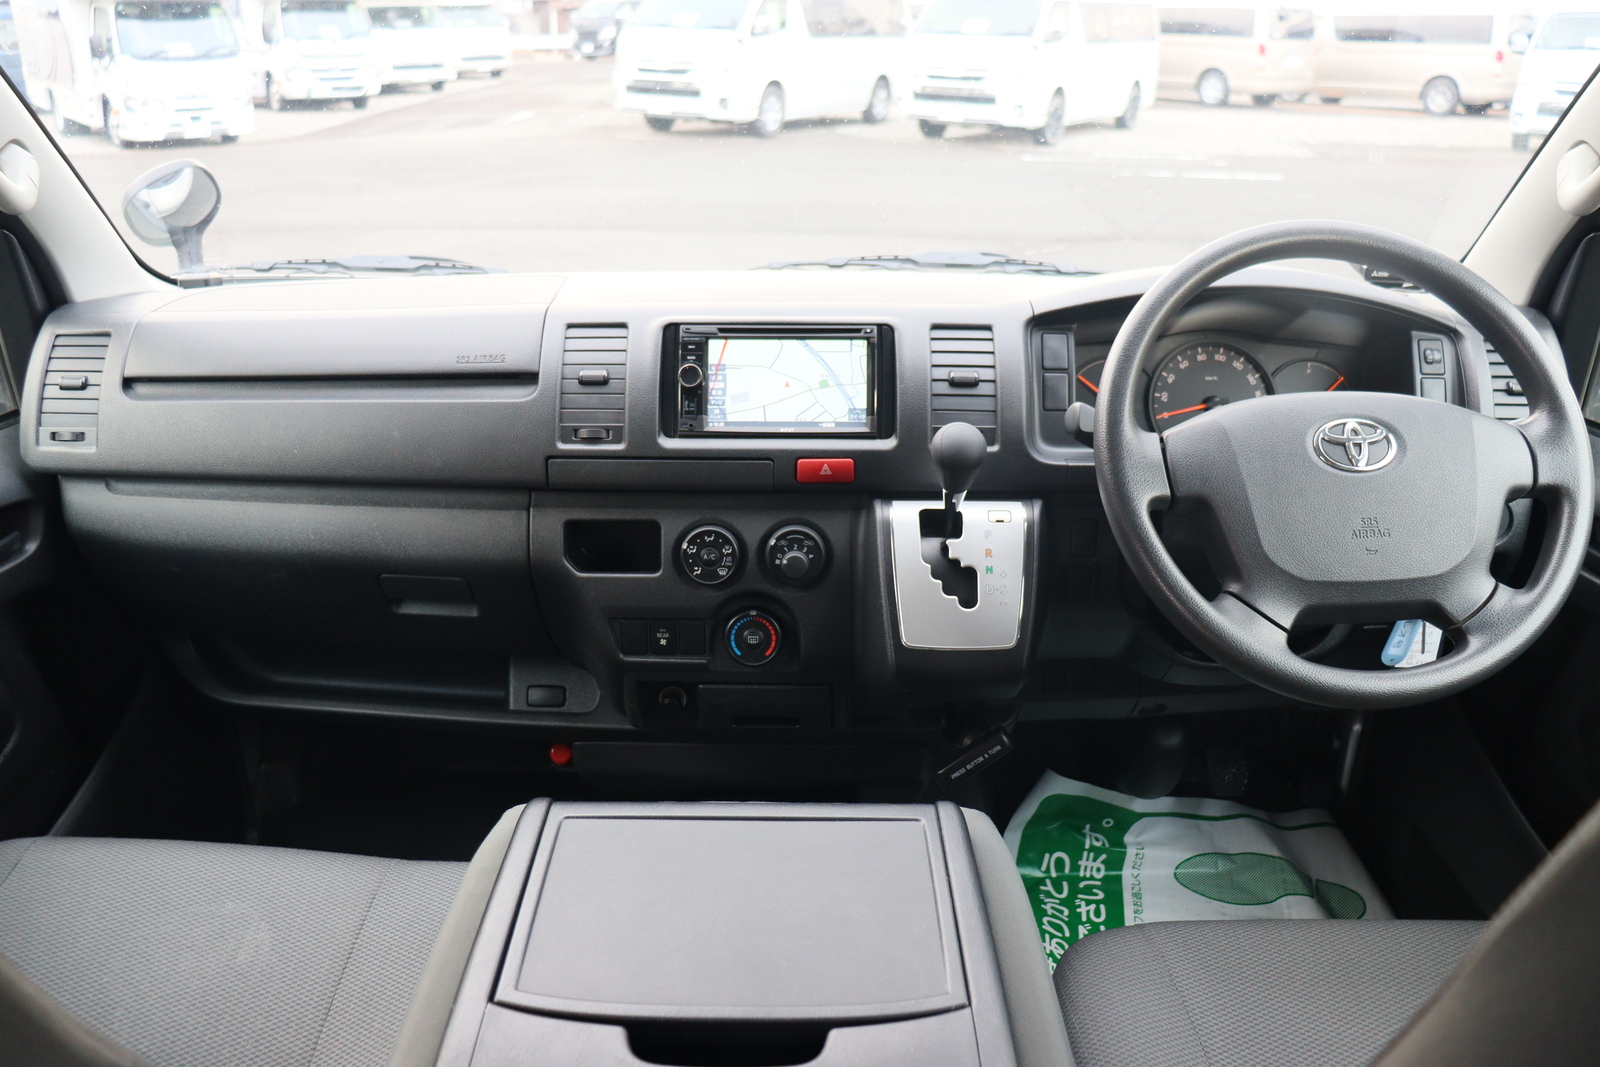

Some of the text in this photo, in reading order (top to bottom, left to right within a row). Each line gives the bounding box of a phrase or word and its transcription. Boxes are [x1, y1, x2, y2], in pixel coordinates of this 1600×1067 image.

[456, 354, 506, 363] SRS AIRBAG
[1197, 354, 1207, 362] 80
[1214, 354, 1226, 362] 100
[1179, 360, 1189, 369] 60
[1232, 360, 1243, 370] 120
[1167, 374, 1176, 384] 40
[1246, 373, 1257, 385] 140
[1161, 392, 1168, 402] 20
[1360, 517, 1379, 527] SRS
[984, 530, 992, 539] P
[1351, 528, 1391, 540] AIRBAG
[703, 553, 716, 561] A/C
[985, 548, 993, 558] R
[985, 565, 993, 574] N
[951, 767, 966, 779] PRESS
[966, 756, 984, 770] BUTTON
[988, 744, 1002, 755] TURN
